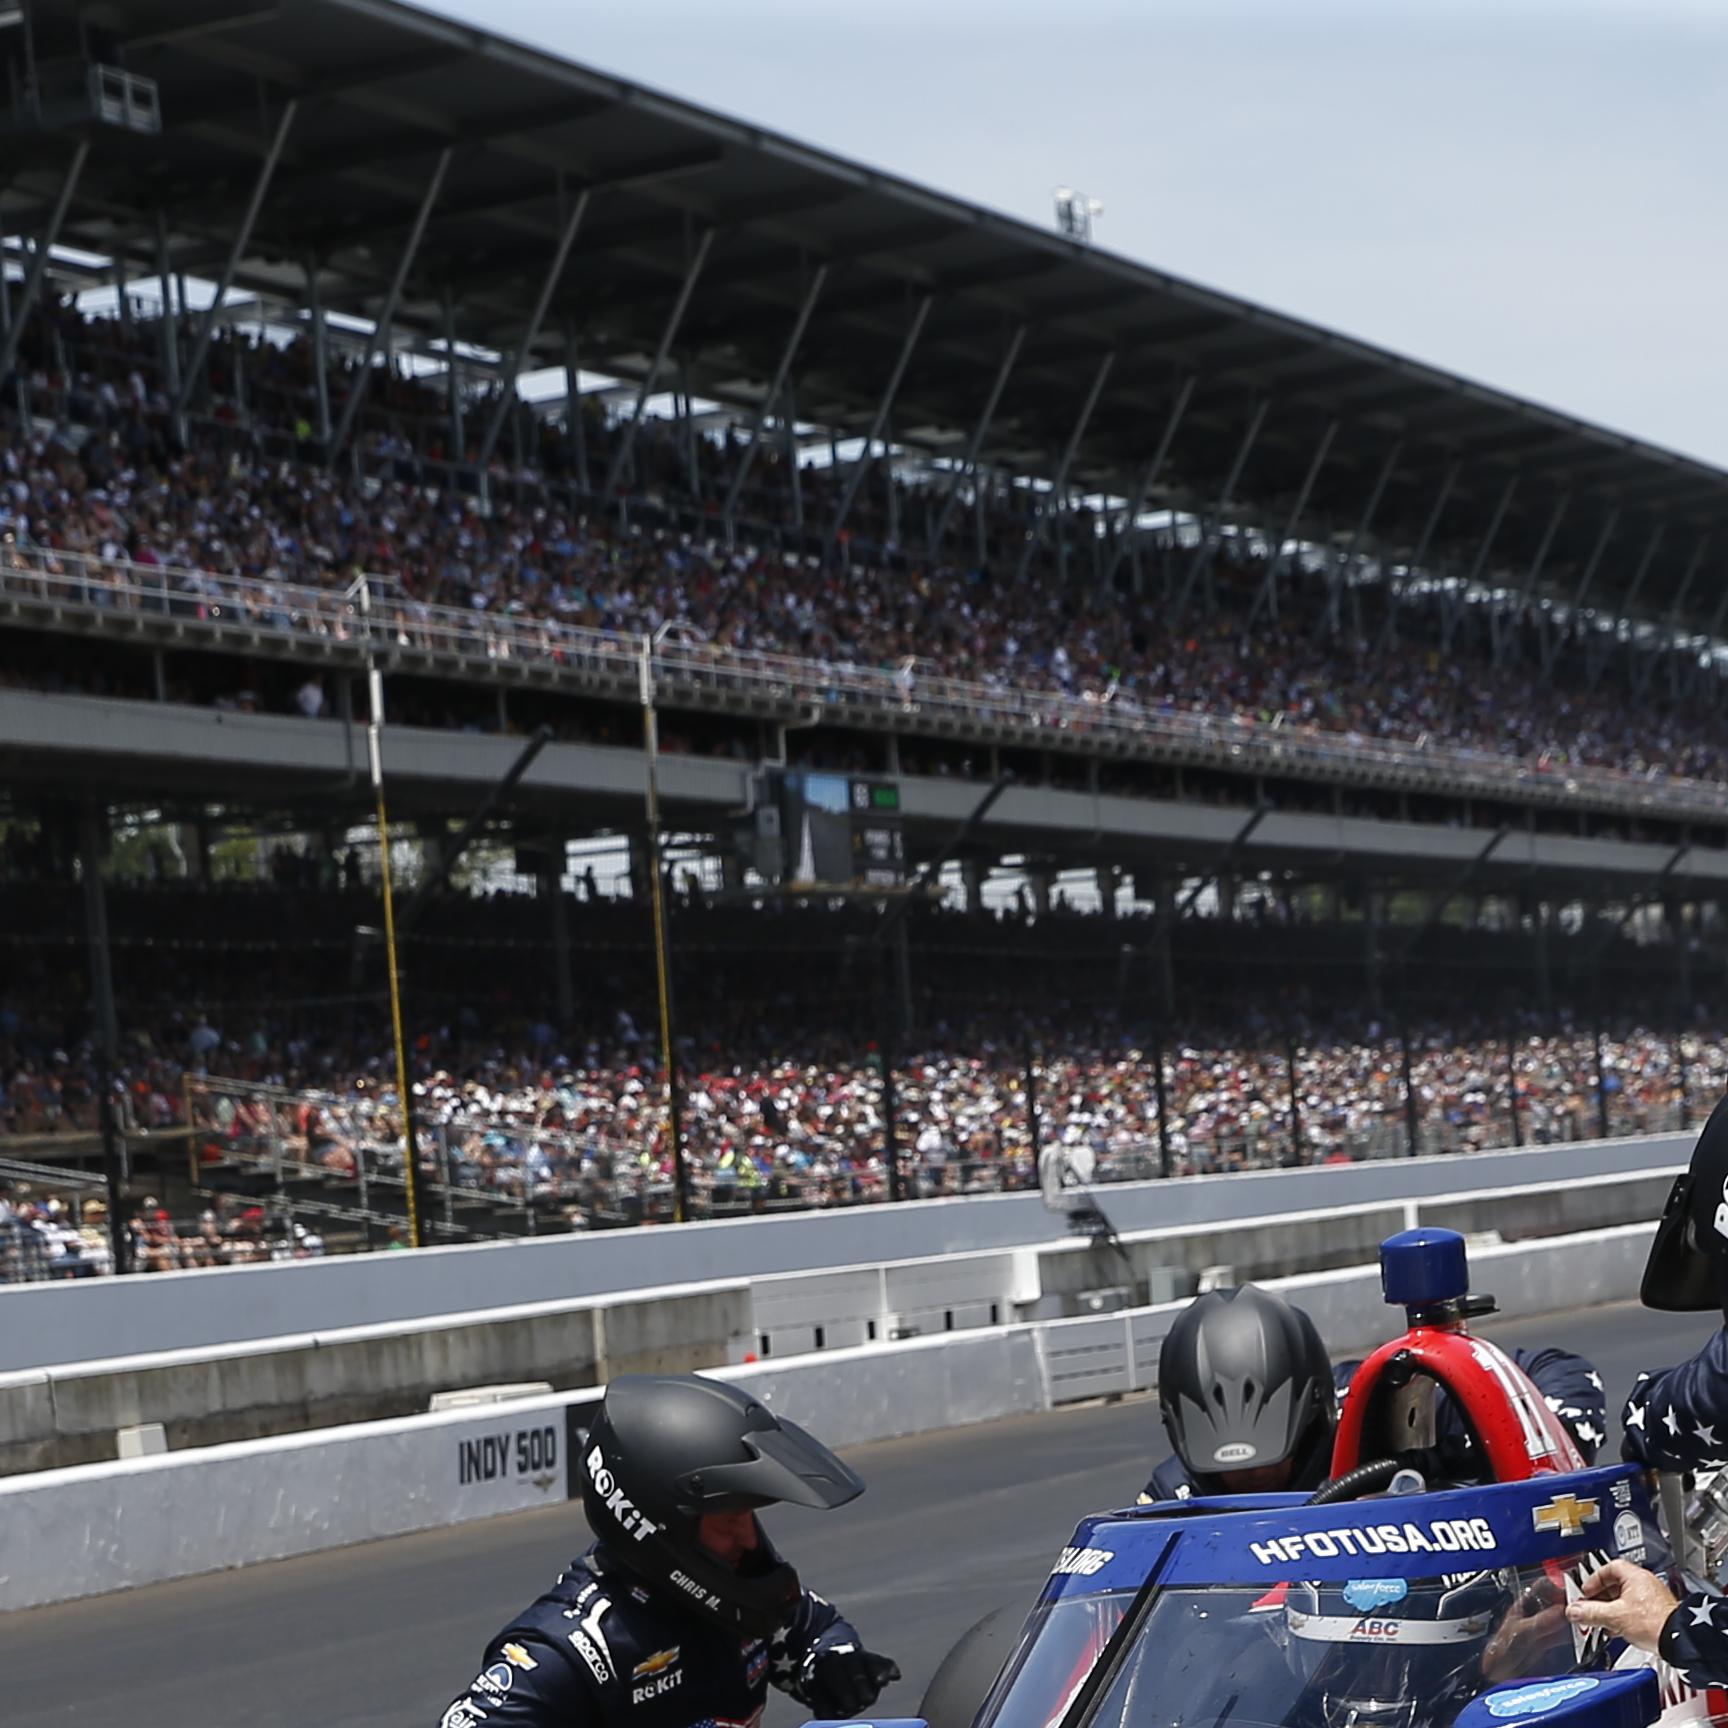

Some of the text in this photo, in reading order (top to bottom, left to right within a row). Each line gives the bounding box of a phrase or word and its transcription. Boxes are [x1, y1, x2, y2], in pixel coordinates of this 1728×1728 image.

[459, 1426, 556, 1485] INDY 500
[1220, 1446, 1253, 1459] BELL
[1248, 1517, 1497, 1565] HFOTUSA.ORG
[670, 1569, 722, 1612] CHRIS M.
[1350, 1620, 1400, 1636] ABC
